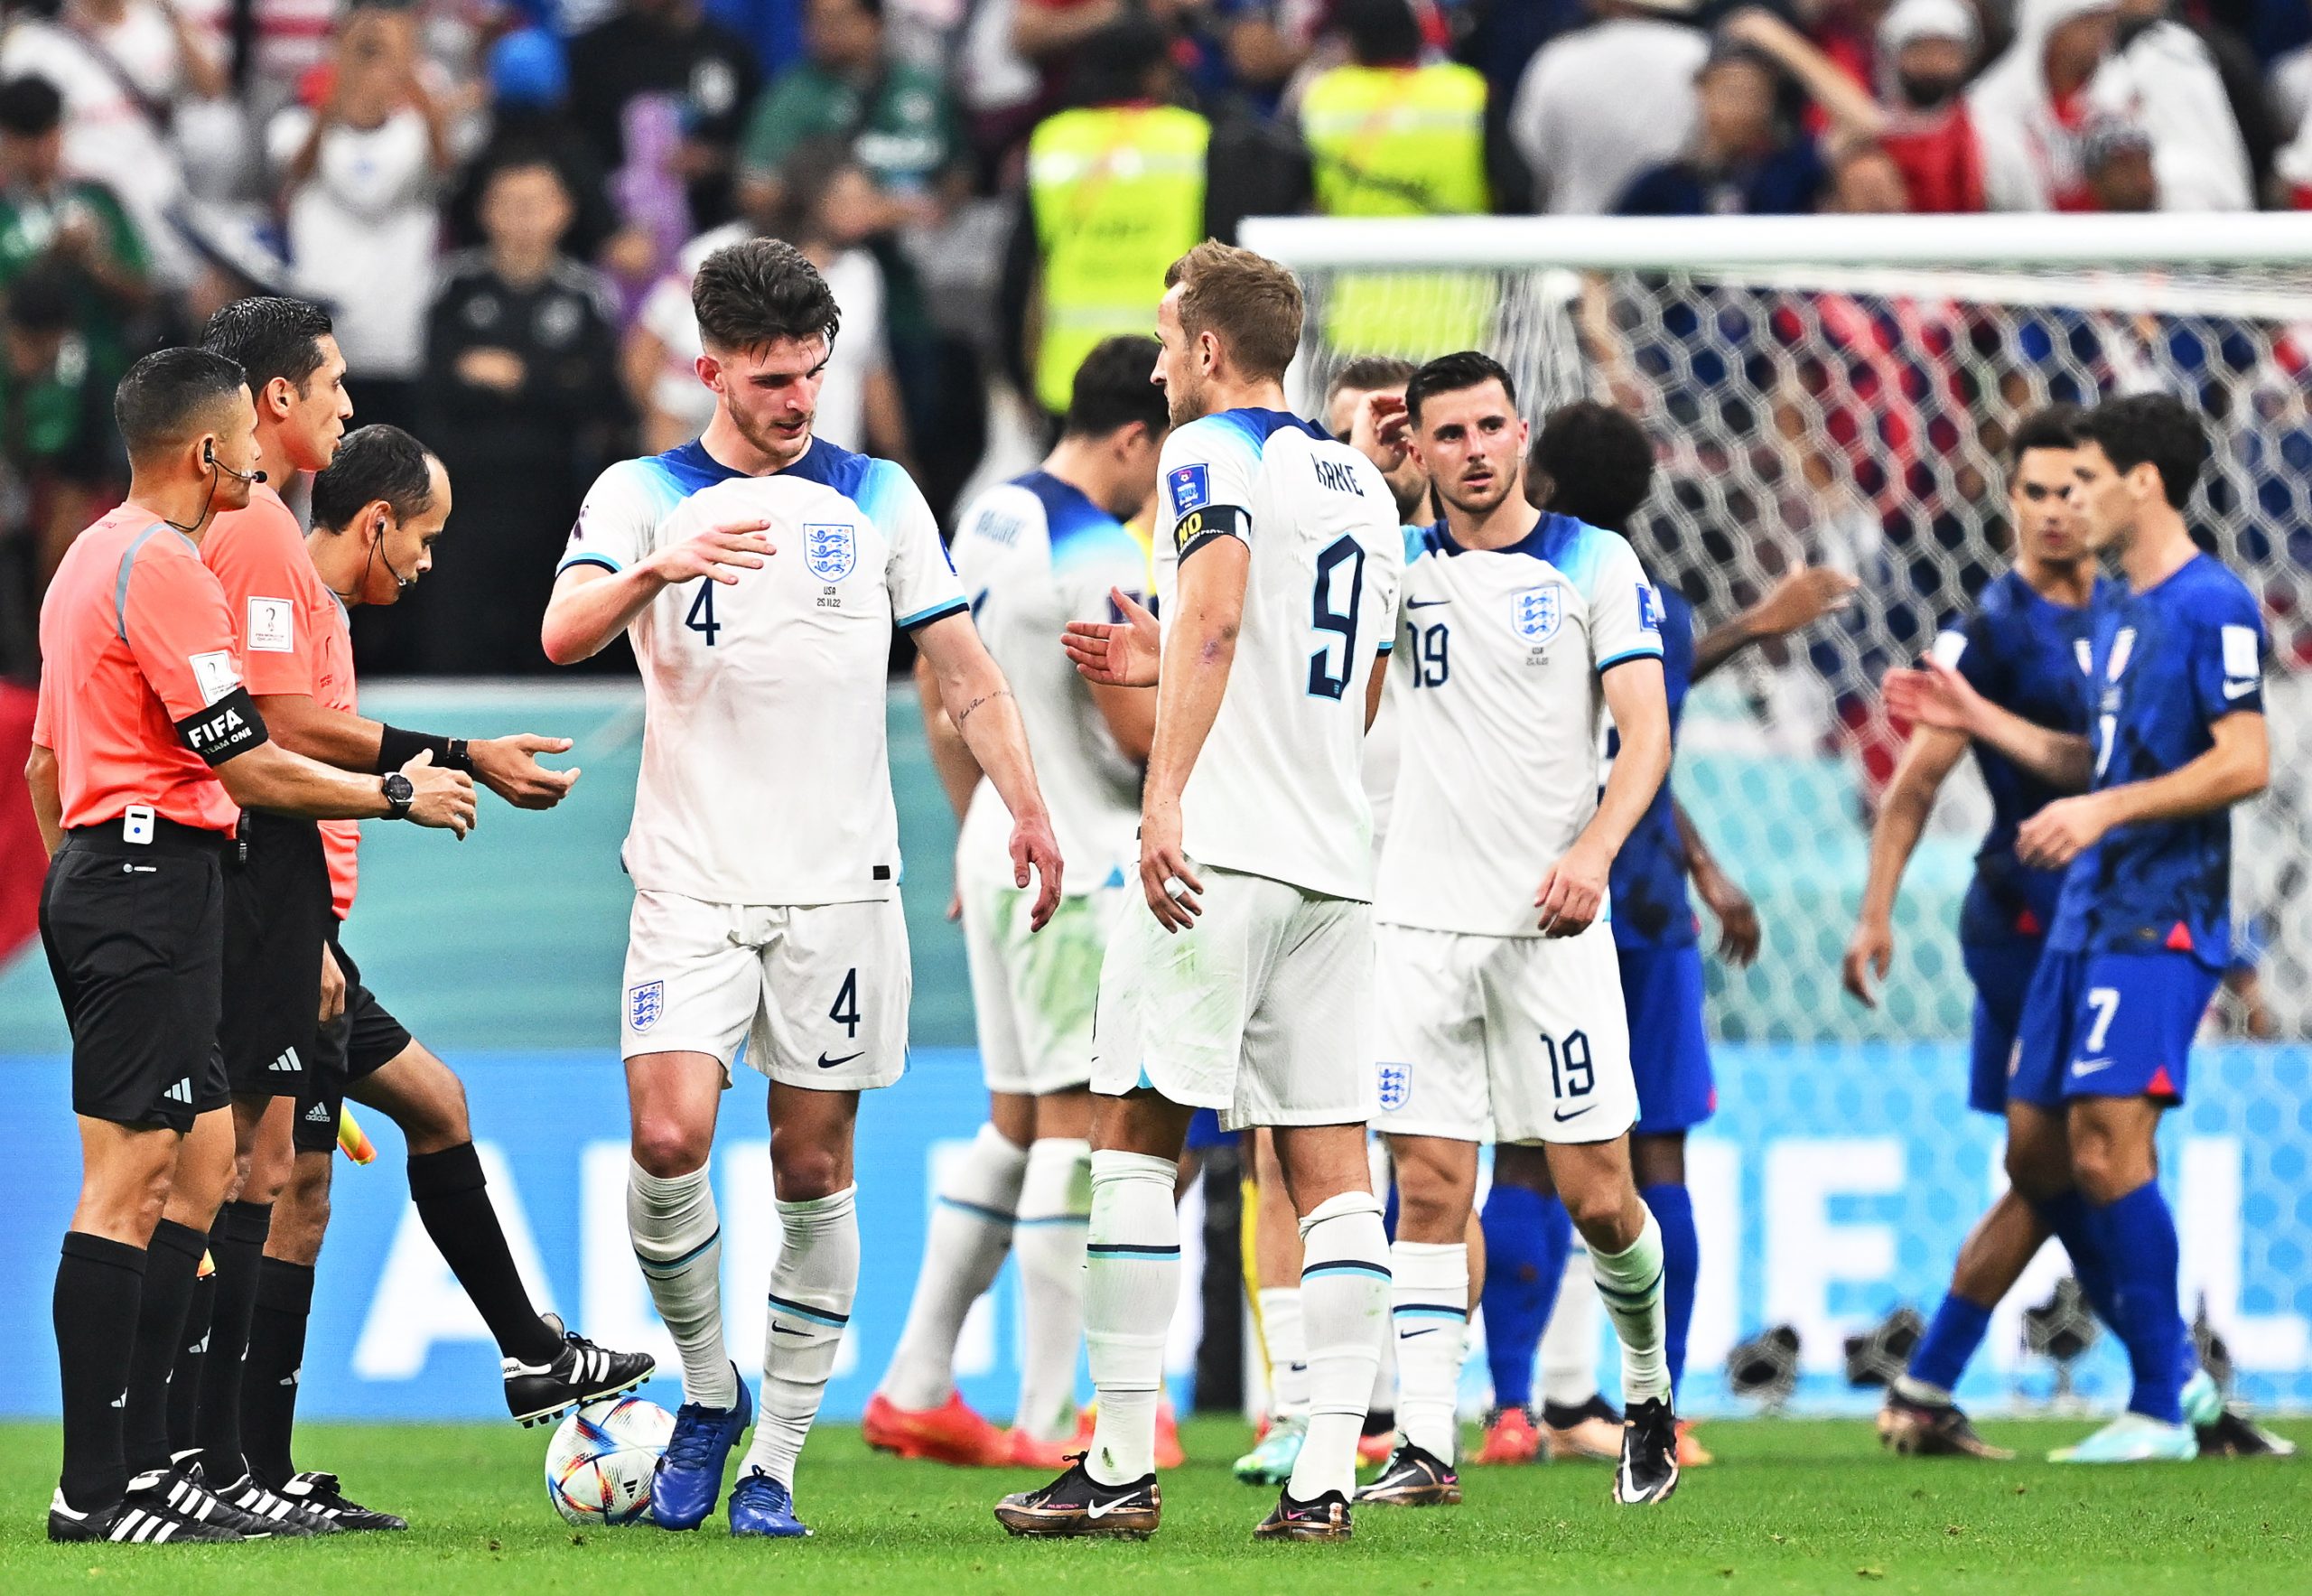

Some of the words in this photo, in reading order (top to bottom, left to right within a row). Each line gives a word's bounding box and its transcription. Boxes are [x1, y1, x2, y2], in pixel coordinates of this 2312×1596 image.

[1310, 452, 1365, 497] KANE
[1179, 512, 1202, 548] NO
[685, 576, 721, 646] 4
[823, 585, 836, 596] USA
[1306, 532, 1366, 703] 9
[1406, 621, 1450, 688] 19
[188, 708, 244, 749] FIFA
[203, 739, 230, 754] TEAM
[230, 726, 253, 743] ONE
[828, 967, 861, 1038] 4
[2085, 986, 2121, 1053] 7
[1540, 1029, 1595, 1097] 19
[305, 1114, 331, 1123] adidas
